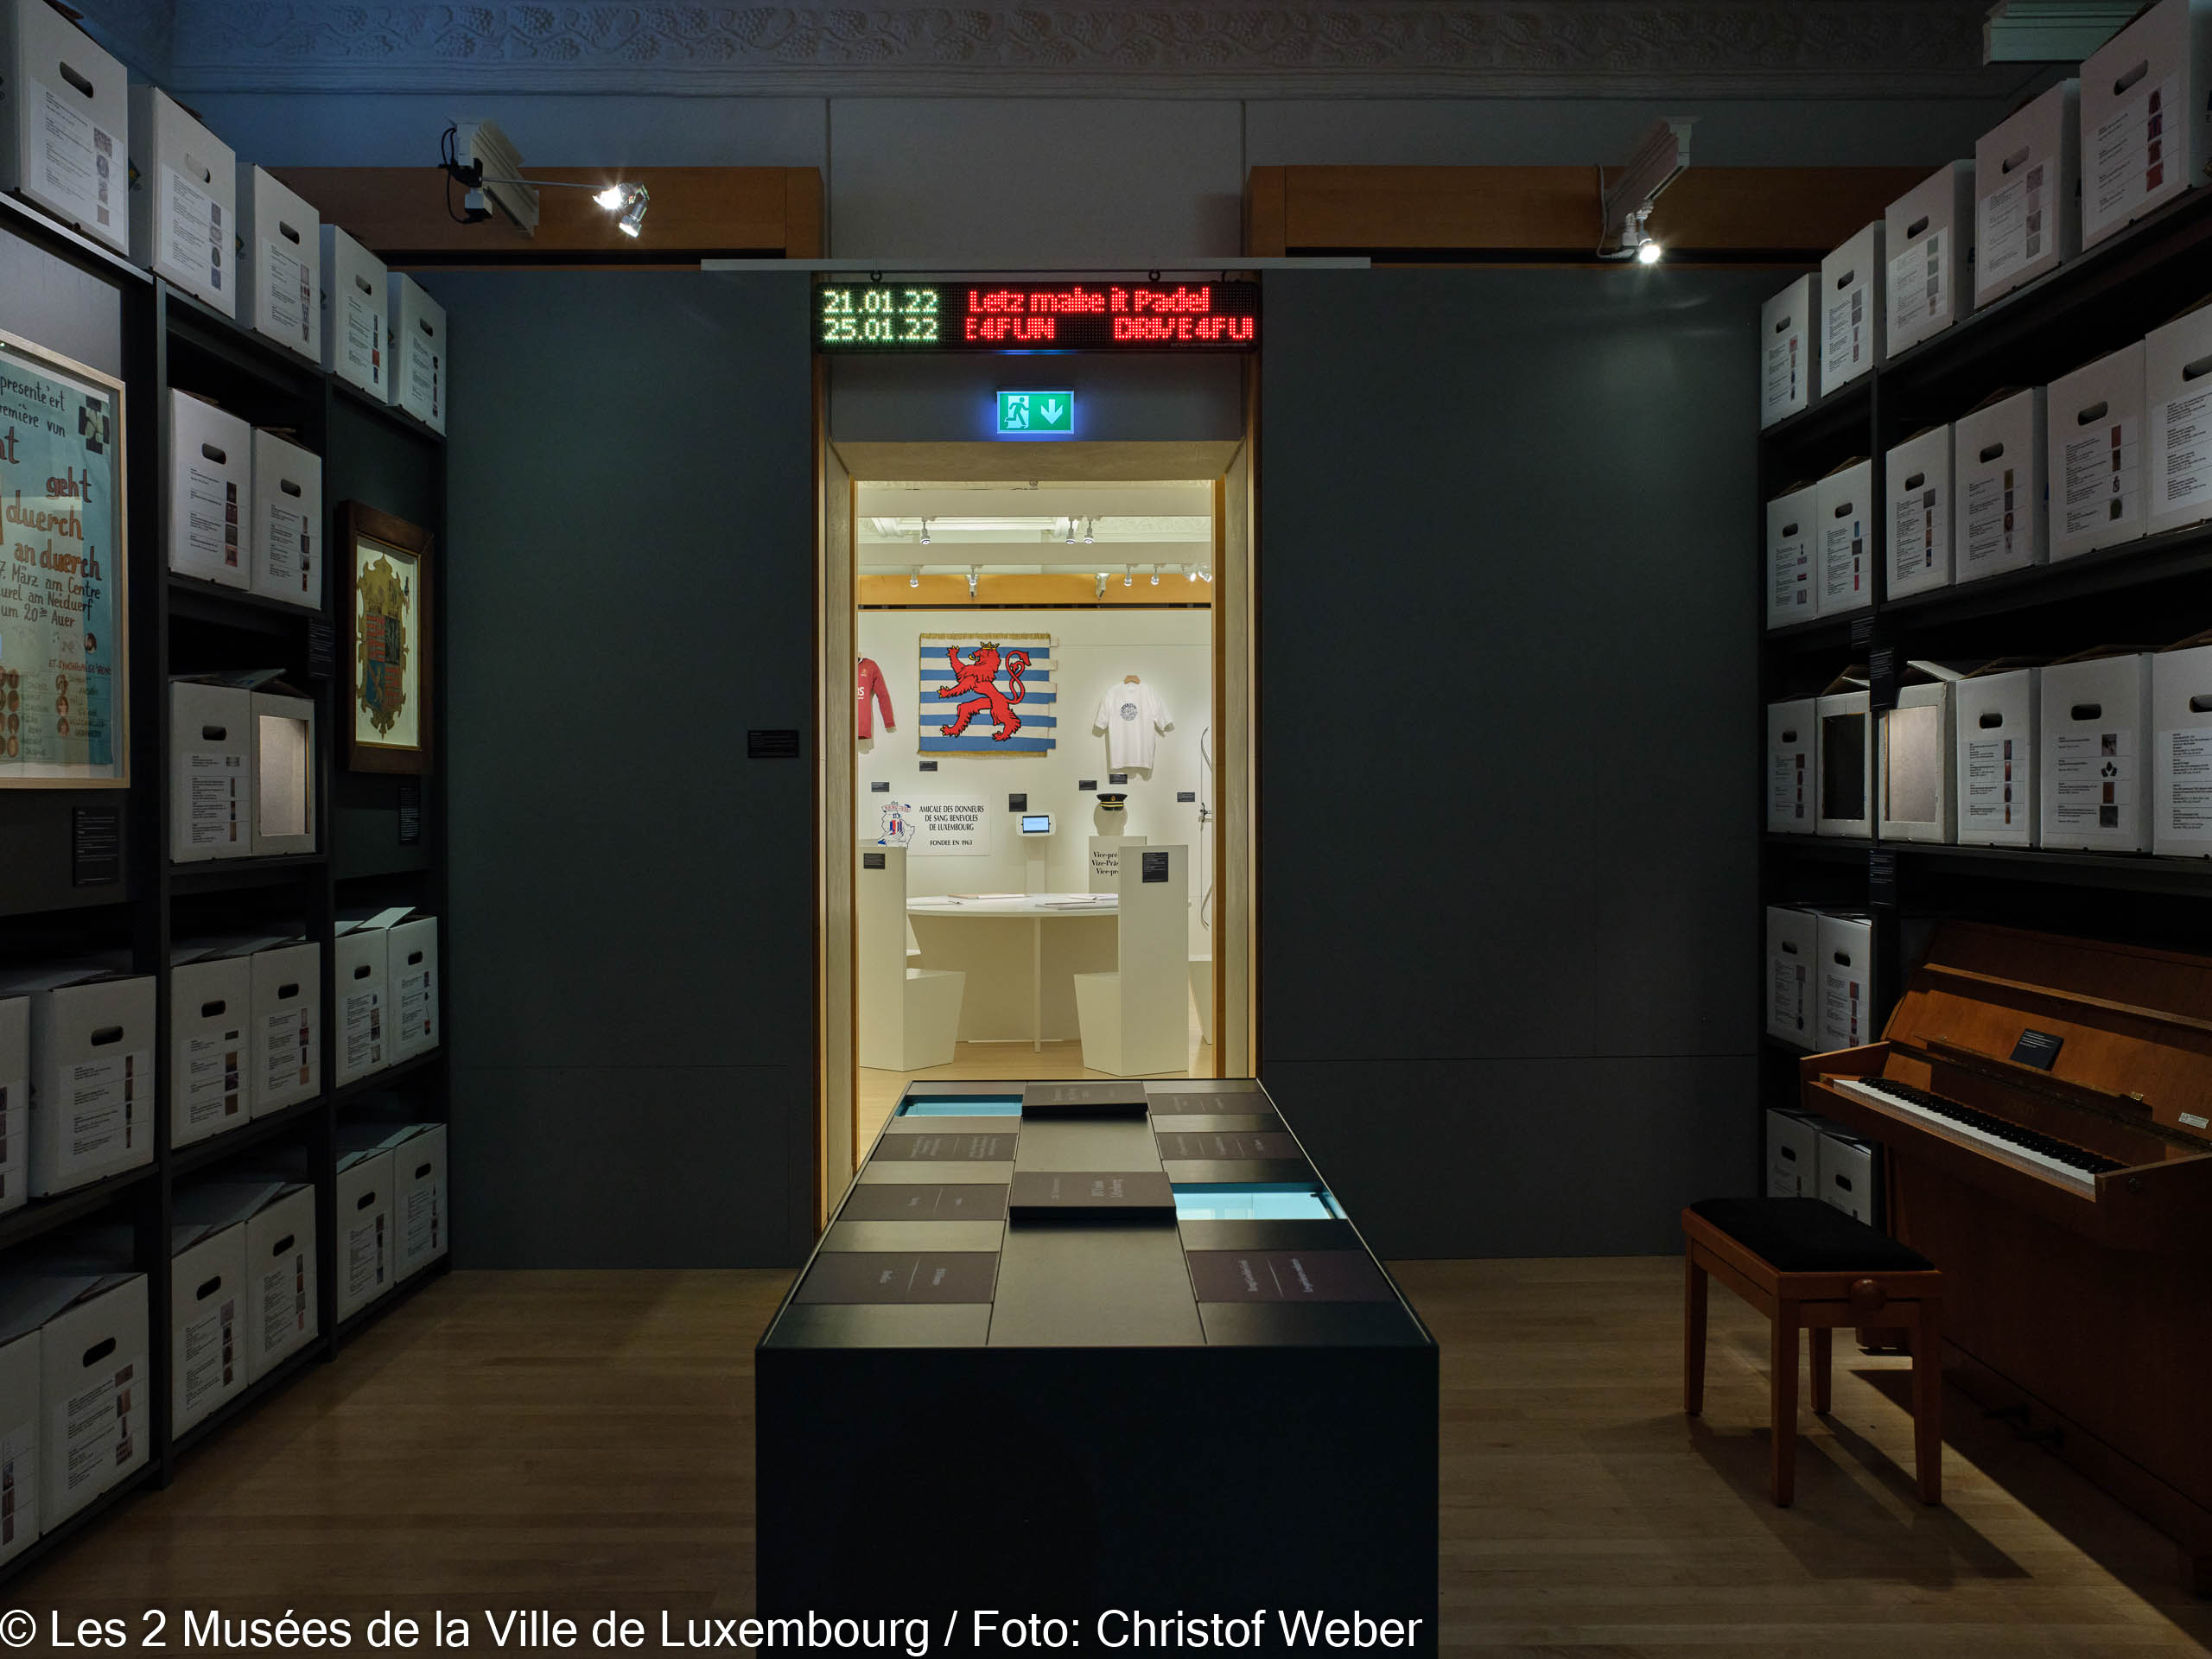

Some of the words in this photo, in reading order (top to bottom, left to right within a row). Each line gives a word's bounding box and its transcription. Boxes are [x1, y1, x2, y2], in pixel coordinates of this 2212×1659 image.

[823, 290, 938, 313] 21.01.22
[969, 290, 1025, 312] Letz
[1030, 287, 1105, 312] make
[1110, 287, 1128, 312] it
[1135, 287, 1210, 312] Padel
[823, 318, 938, 340] 25.01.22
[47, 421, 66, 438] vun
[46, 466, 92, 504] geht
[6, 489, 84, 540] duerch
[14, 542, 36, 566] an
[40, 538, 103, 581] duerch
[12, 563, 39, 587] März
[45, 578, 63, 592] am
[68, 575, 101, 600] Centre
[28, 591, 44, 606] am
[48, 591, 93, 622] Neiduerf
[51, 603, 76, 627] Auer
